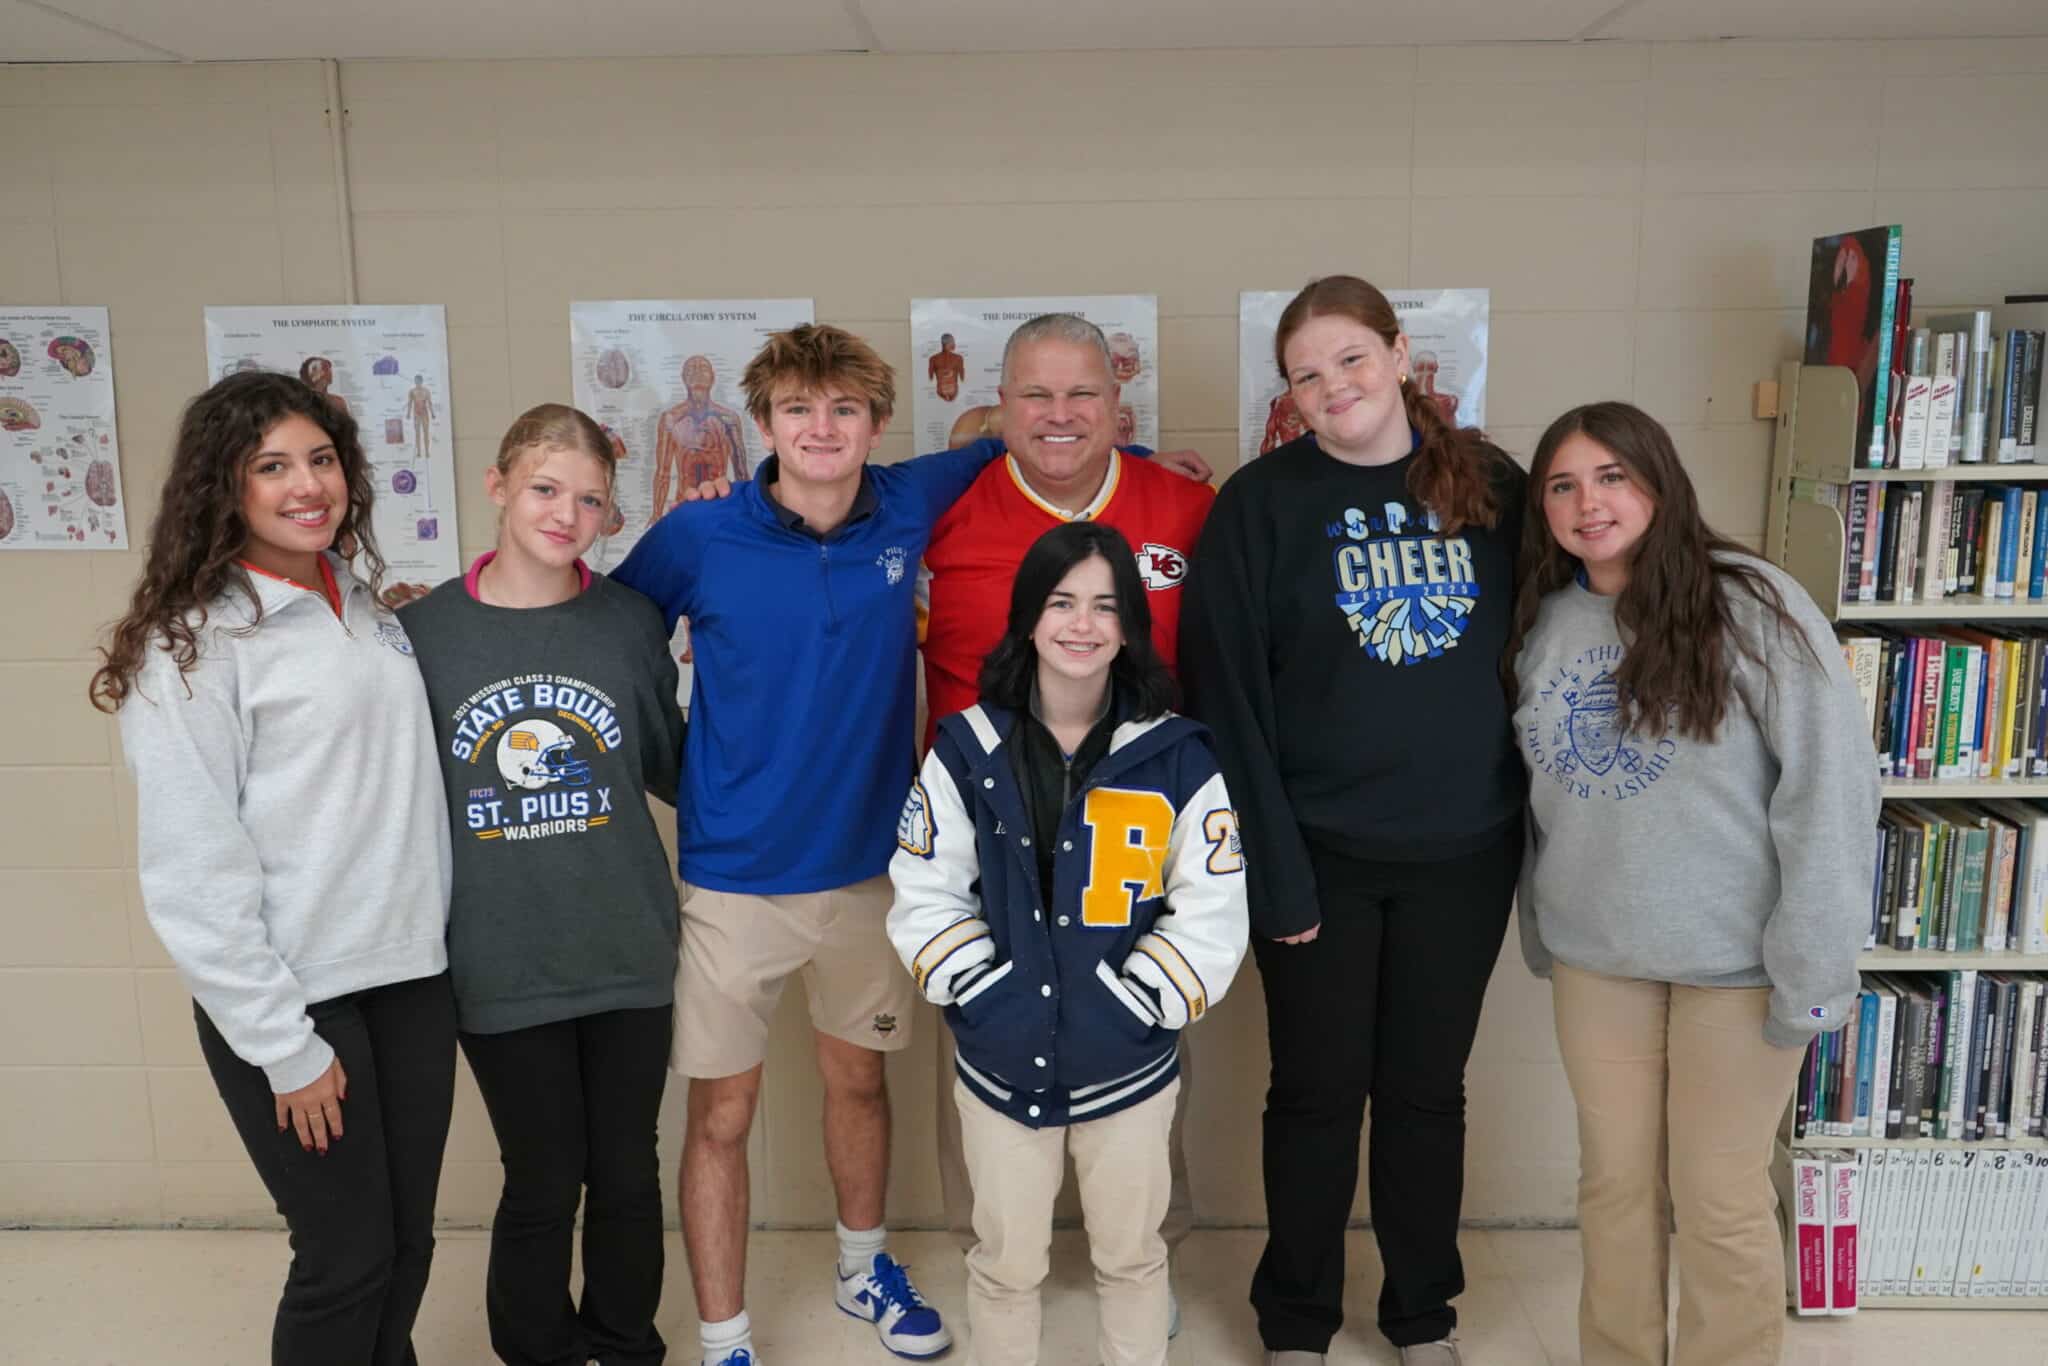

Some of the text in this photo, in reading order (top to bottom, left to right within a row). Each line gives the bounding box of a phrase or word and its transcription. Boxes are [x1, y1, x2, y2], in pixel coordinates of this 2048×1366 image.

[272, 319, 289, 328] THE
[291, 319, 340, 328] LYMPHATIC
[649, 312, 715, 321] CIRCULATORY
[718, 312, 757, 320] SYSTEM
[1150, 554, 1184, 580] KC
[1336, 538, 1476, 593] CHEER
[1350, 585, 1468, 603] 2024 2025
[1923, 655, 1941, 704] Blood
[452, 673, 617, 721] 2021 MISSOURI CLASS 3 CHAMPIONSHIP
[451, 683, 623, 761] STATE BOUND
[1614, 739, 1677, 800] CHRIST
[467, 787, 613, 828] ST. PIUS X
[503, 818, 588, 841] WARRIORS
[1934, 1152, 1945, 1166] 6
[1964, 1151, 1976, 1168] 7
[1994, 1155, 2006, 1170] 8
[2023, 1152, 2034, 1166] 9
[2036, 1156, 2048, 1168] 10
